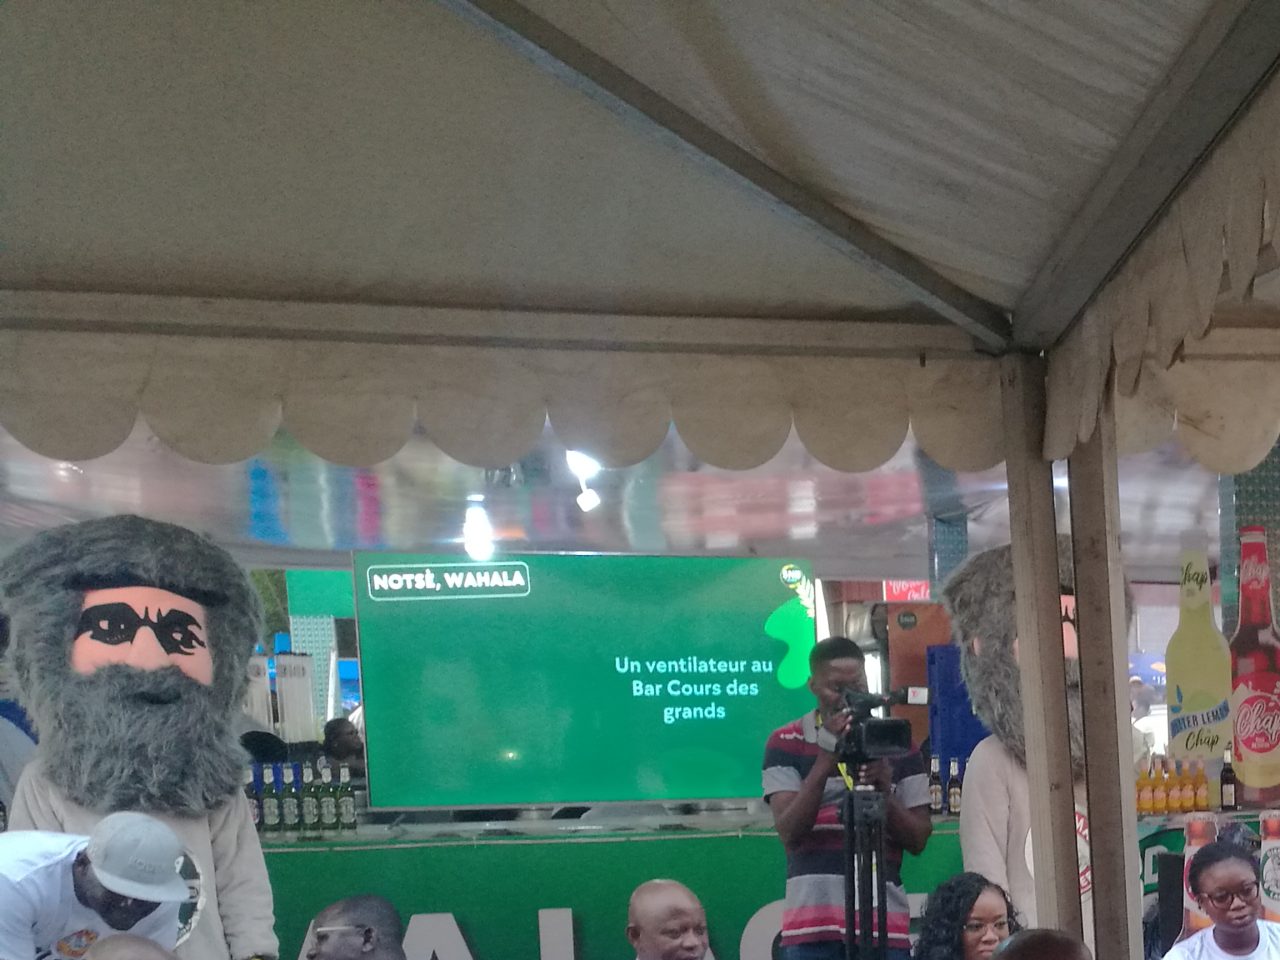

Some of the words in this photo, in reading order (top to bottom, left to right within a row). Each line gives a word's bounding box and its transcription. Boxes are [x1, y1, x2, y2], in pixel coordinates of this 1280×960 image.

[443, 570, 526, 589] WAHALA
[615, 656, 641, 674] Un
[646, 656, 747, 674] ventilateur
[751, 660, 773, 673] au
[632, 679, 662, 696] Bar
[667, 679, 721, 696] Cours
[726, 678, 759, 696] des
[663, 702, 726, 724] grands
[1185, 731, 1220, 752] Chap
